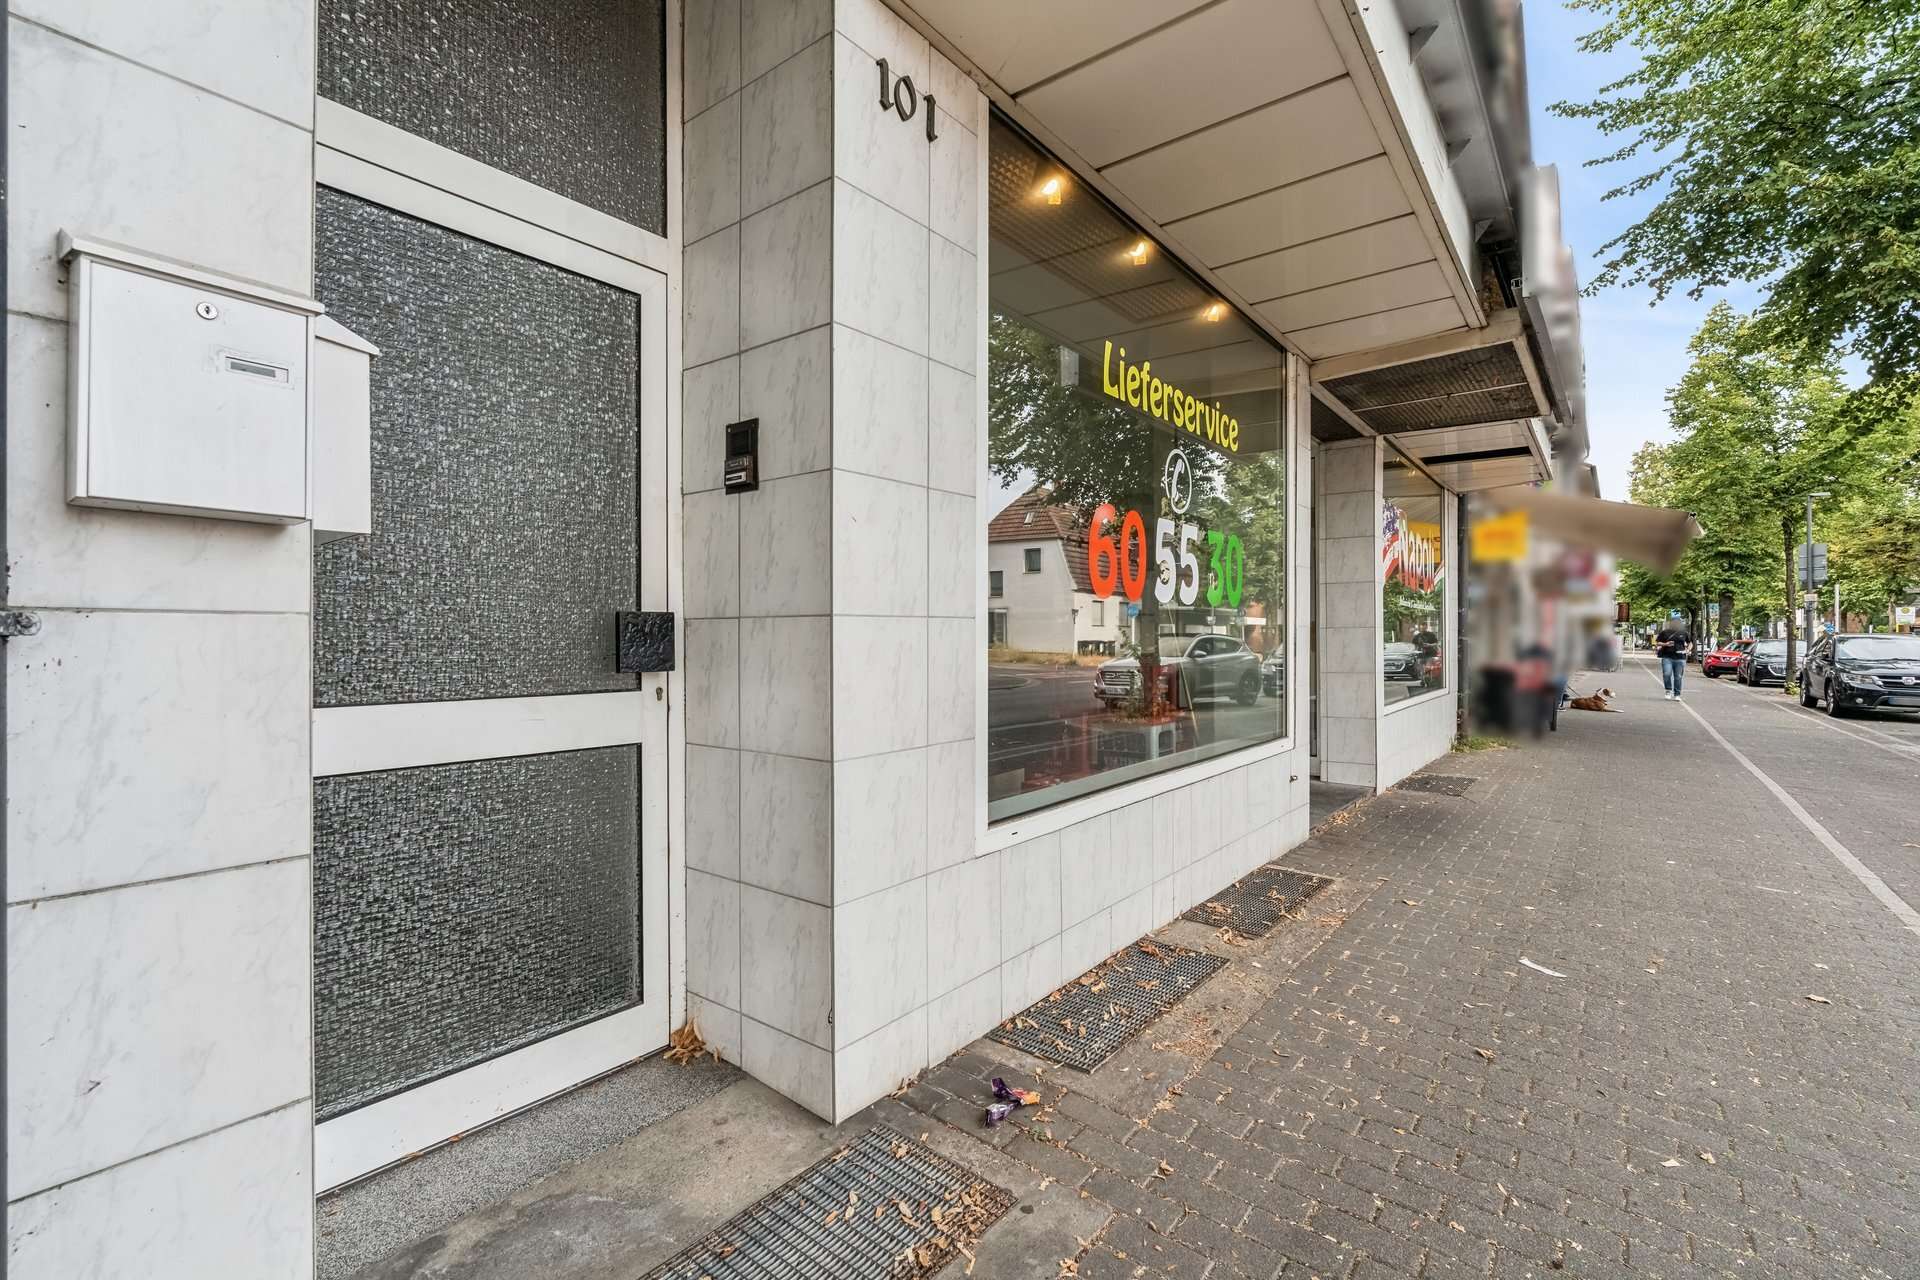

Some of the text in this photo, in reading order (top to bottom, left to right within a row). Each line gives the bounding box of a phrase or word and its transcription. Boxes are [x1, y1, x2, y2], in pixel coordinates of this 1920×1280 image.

[876, 57, 938, 143] 101
[1103, 340, 1239, 452] Lieferservice
[1088, 503, 1243, 608] 60 55 30
